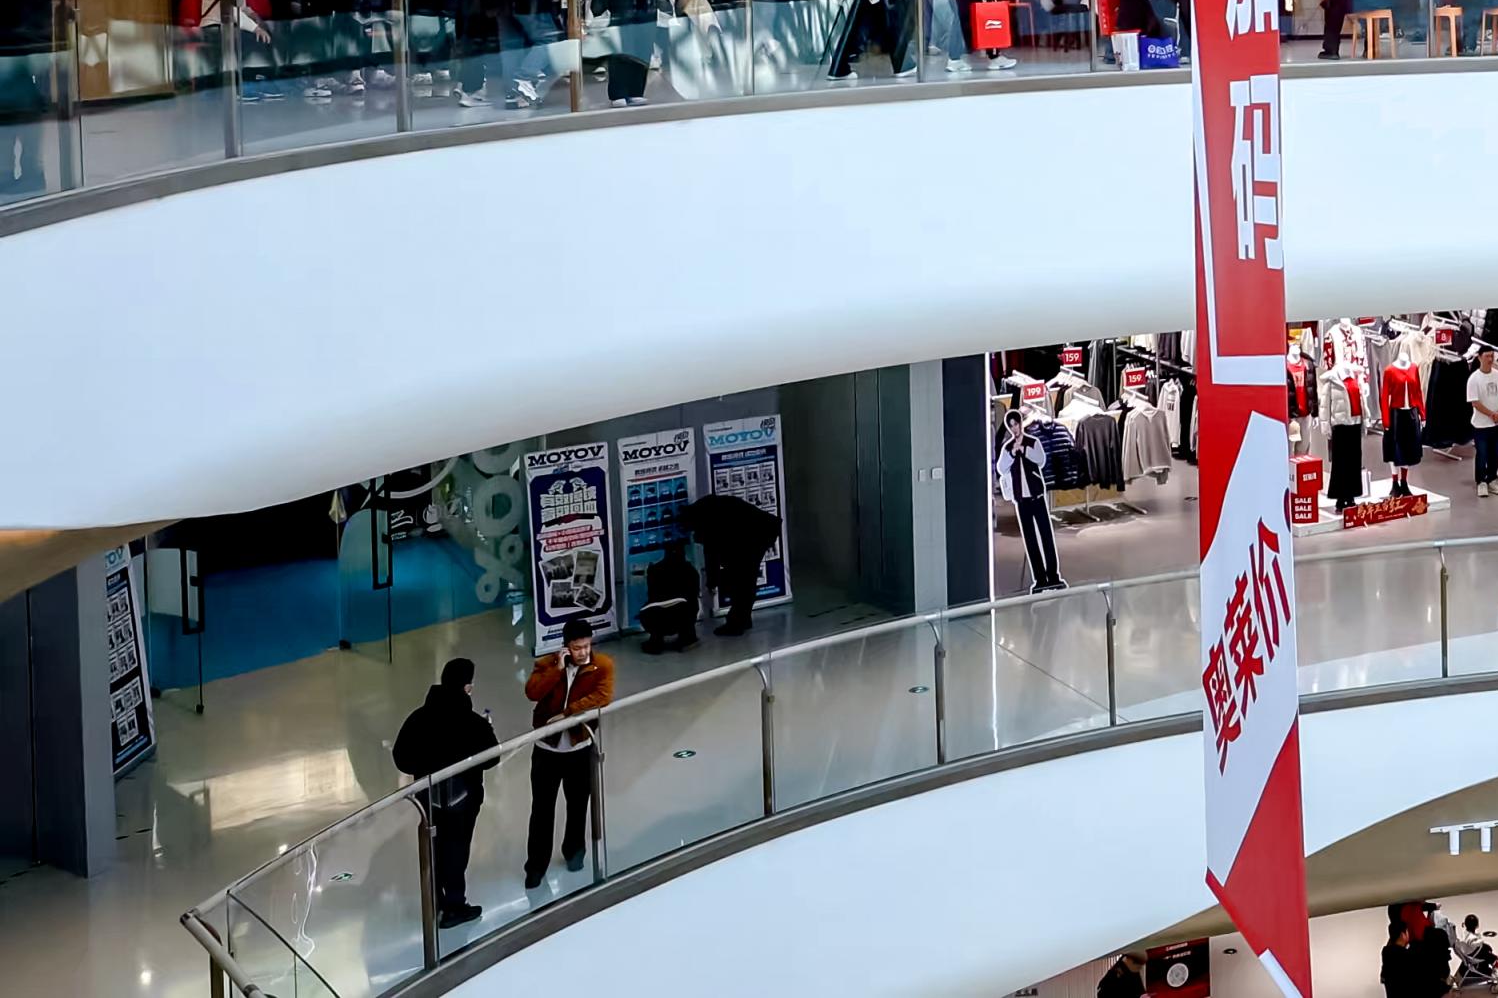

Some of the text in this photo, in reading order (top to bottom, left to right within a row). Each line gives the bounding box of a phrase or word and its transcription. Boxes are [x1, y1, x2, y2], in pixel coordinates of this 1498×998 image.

[1065, 353, 1079, 362] 159
[1129, 374, 1141, 382] 159
[1027, 387, 1041, 396] 199
[709, 428, 776, 445] MOYOV
[528, 445, 604, 467] MOYOV
[623, 440, 689, 461] MOYOV
